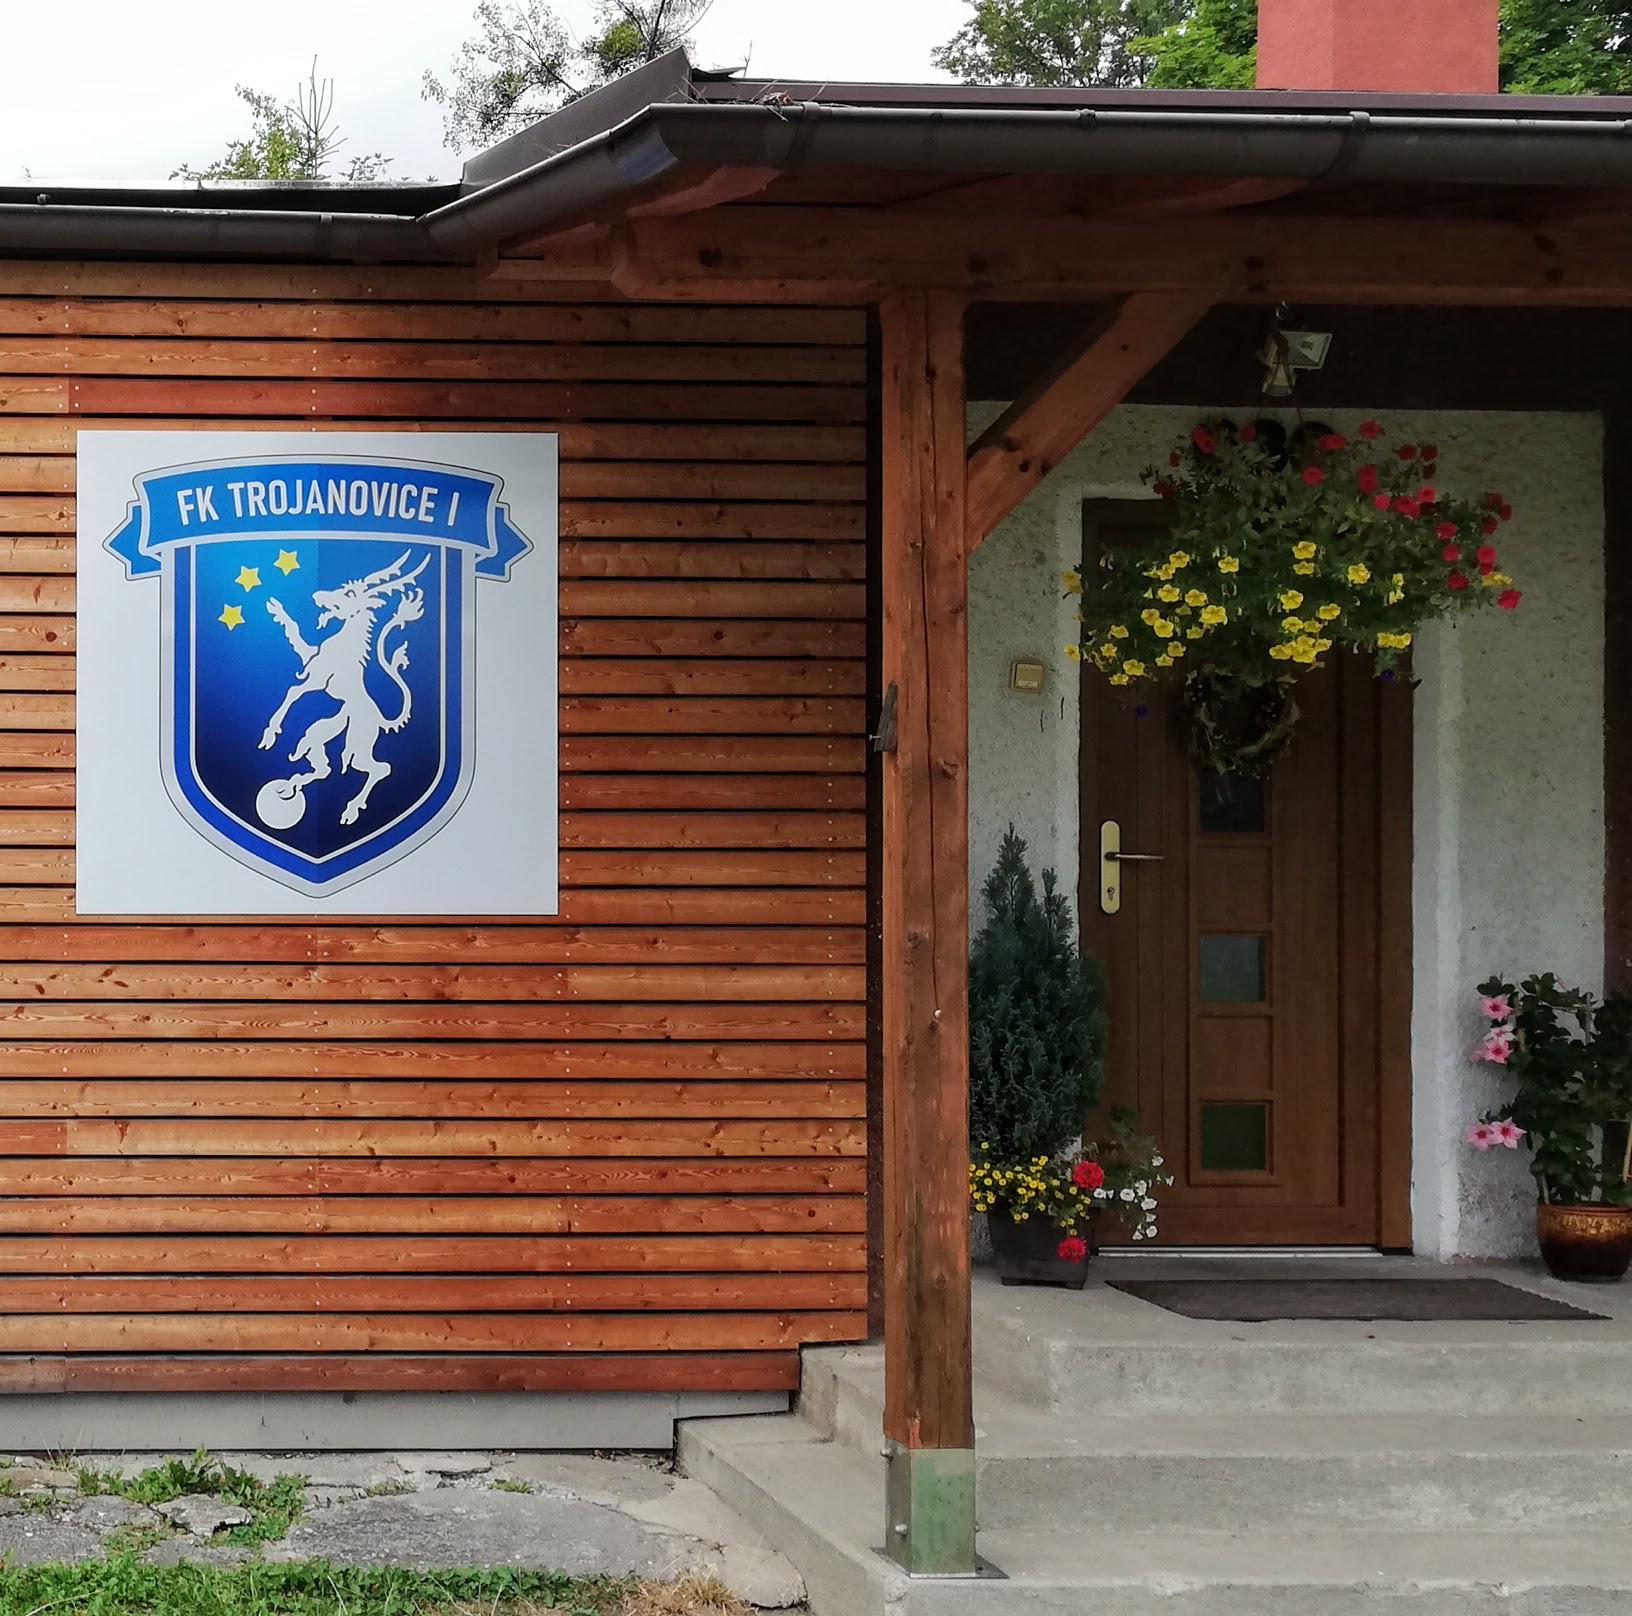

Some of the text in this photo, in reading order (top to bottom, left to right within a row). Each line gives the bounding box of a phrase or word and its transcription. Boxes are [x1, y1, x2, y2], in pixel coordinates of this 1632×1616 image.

[176, 479, 460, 527] FK TROJANOVICE I
